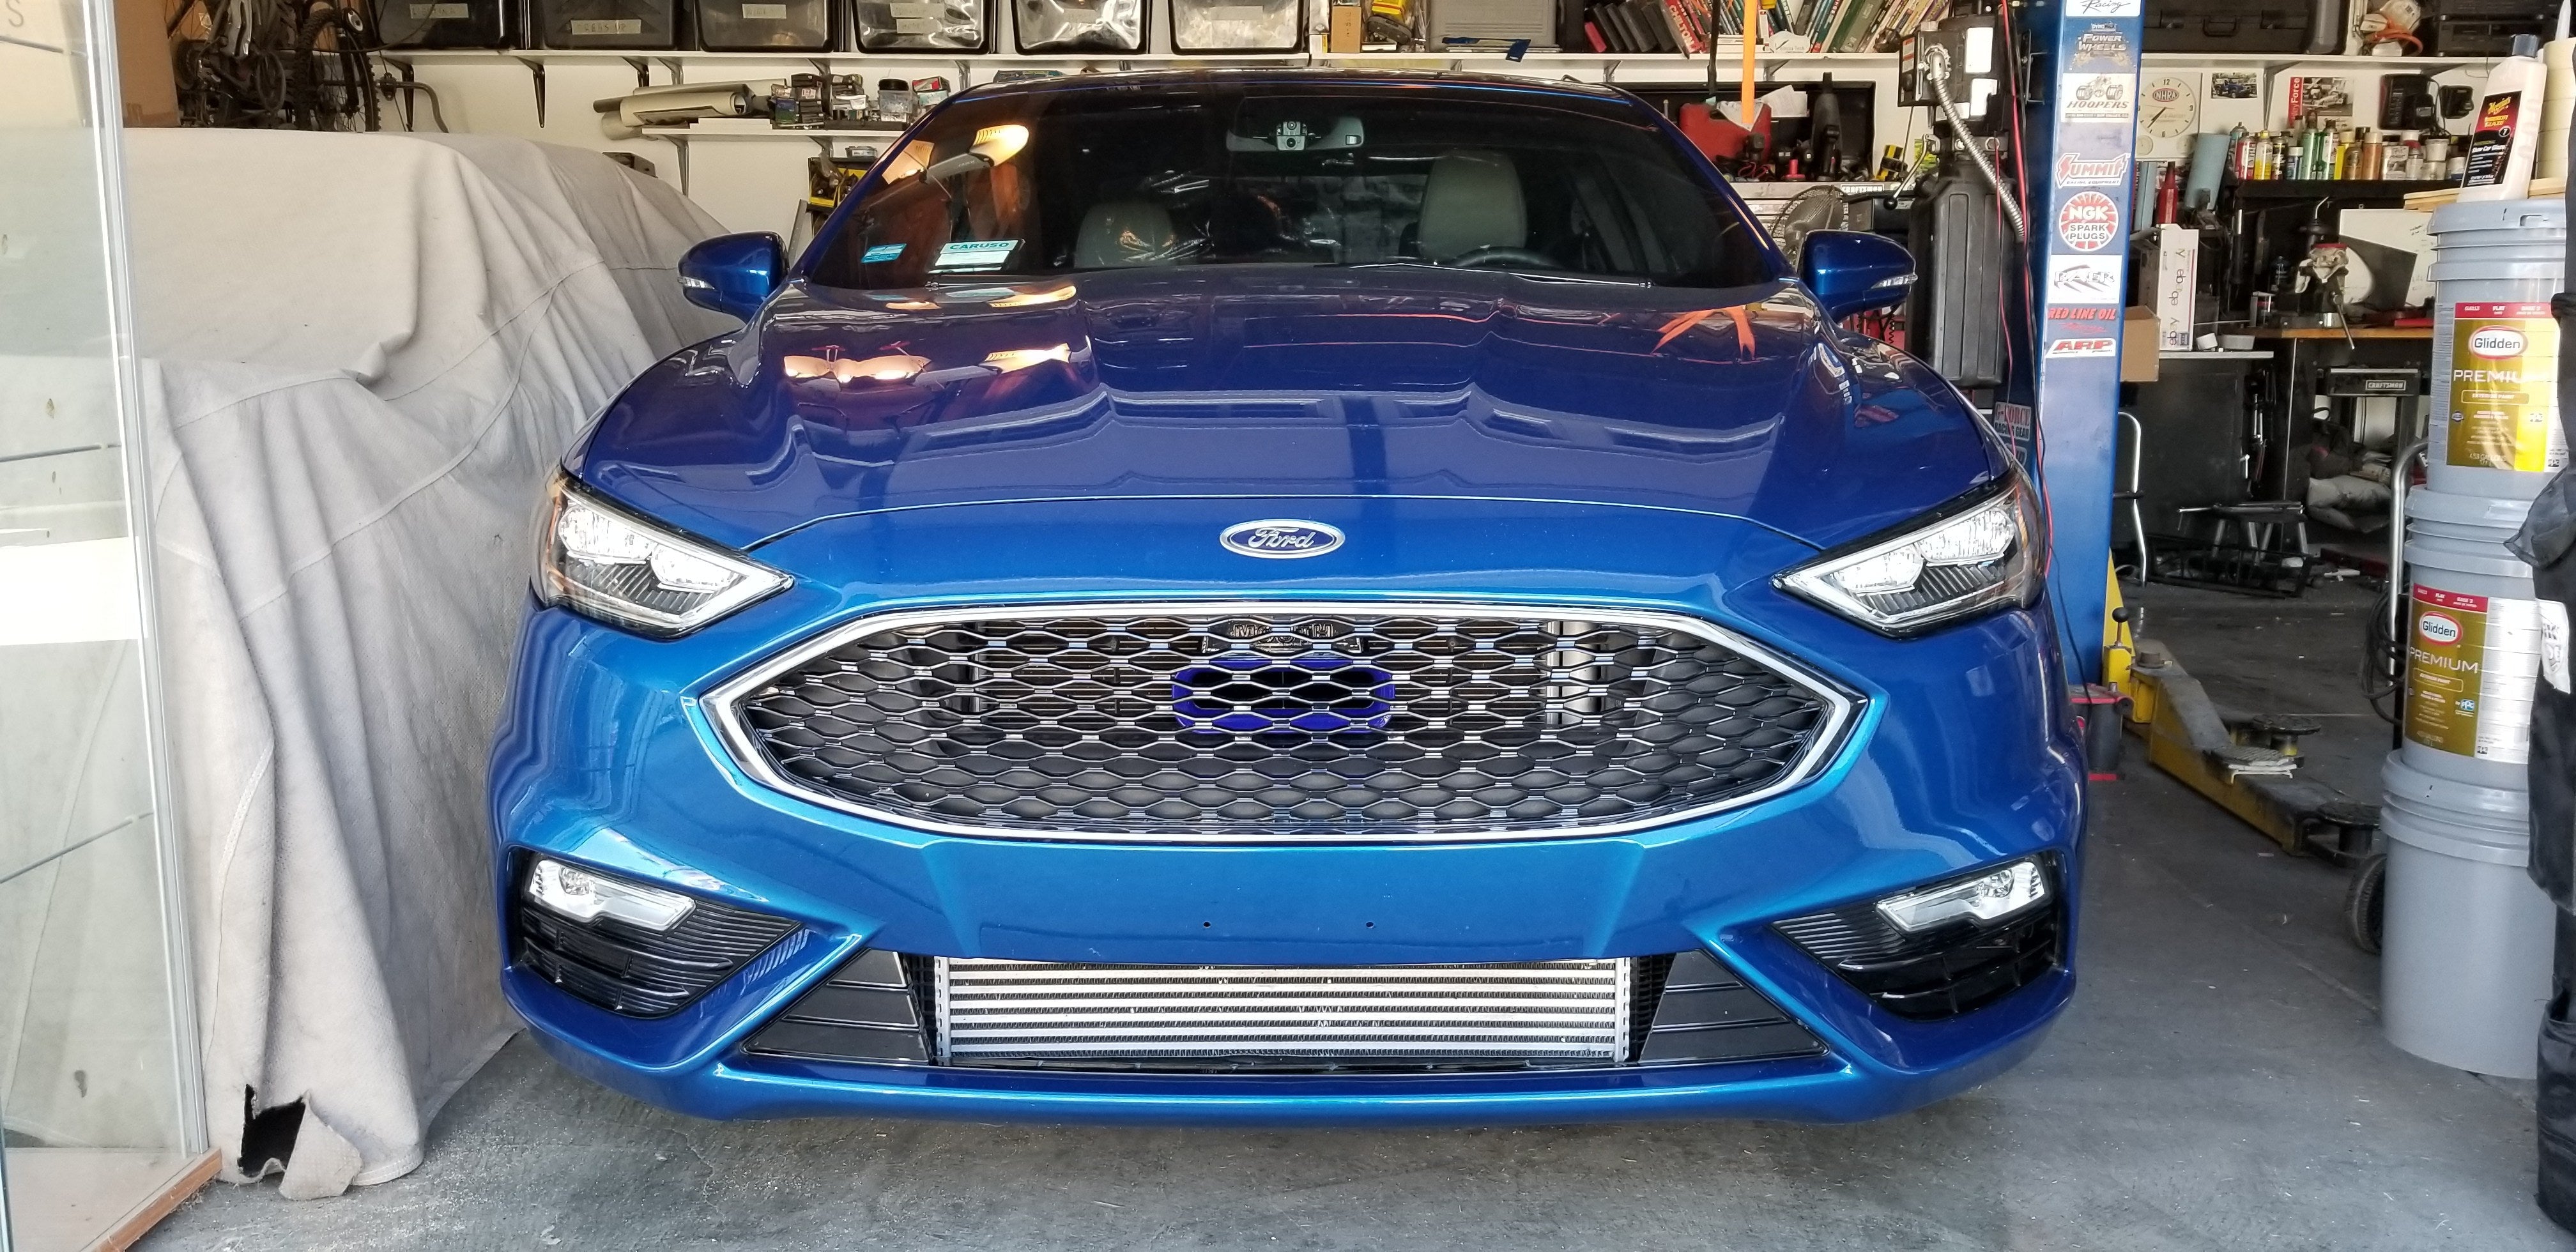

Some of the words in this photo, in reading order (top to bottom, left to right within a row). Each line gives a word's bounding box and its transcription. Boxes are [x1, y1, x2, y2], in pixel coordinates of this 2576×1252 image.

[2080, 0, 2131, 14] Racing
[1669, 4, 1695, 47] CHILTON
[2082, 33, 2122, 42] POWER
[2078, 40, 2126, 51] WHEELS
[2154, 90, 2177, 100] NHRA
[2057, 153, 2126, 187] SUMMIT
[2069, 205, 2109, 221] NGK
[2048, 307, 2069, 319] RED
[2070, 308, 2097, 319] LINE
[2098, 309, 2117, 320] OIL
[2053, 340, 2113, 351] ARP
[2474, 337, 2520, 349] Glidden
[2453, 369, 2548, 383] PREMIU
[1248, 527, 1316, 547] Ford
[2423, 620, 2456, 637] Glidden
[2410, 646, 2478, 674] PREMIUM
